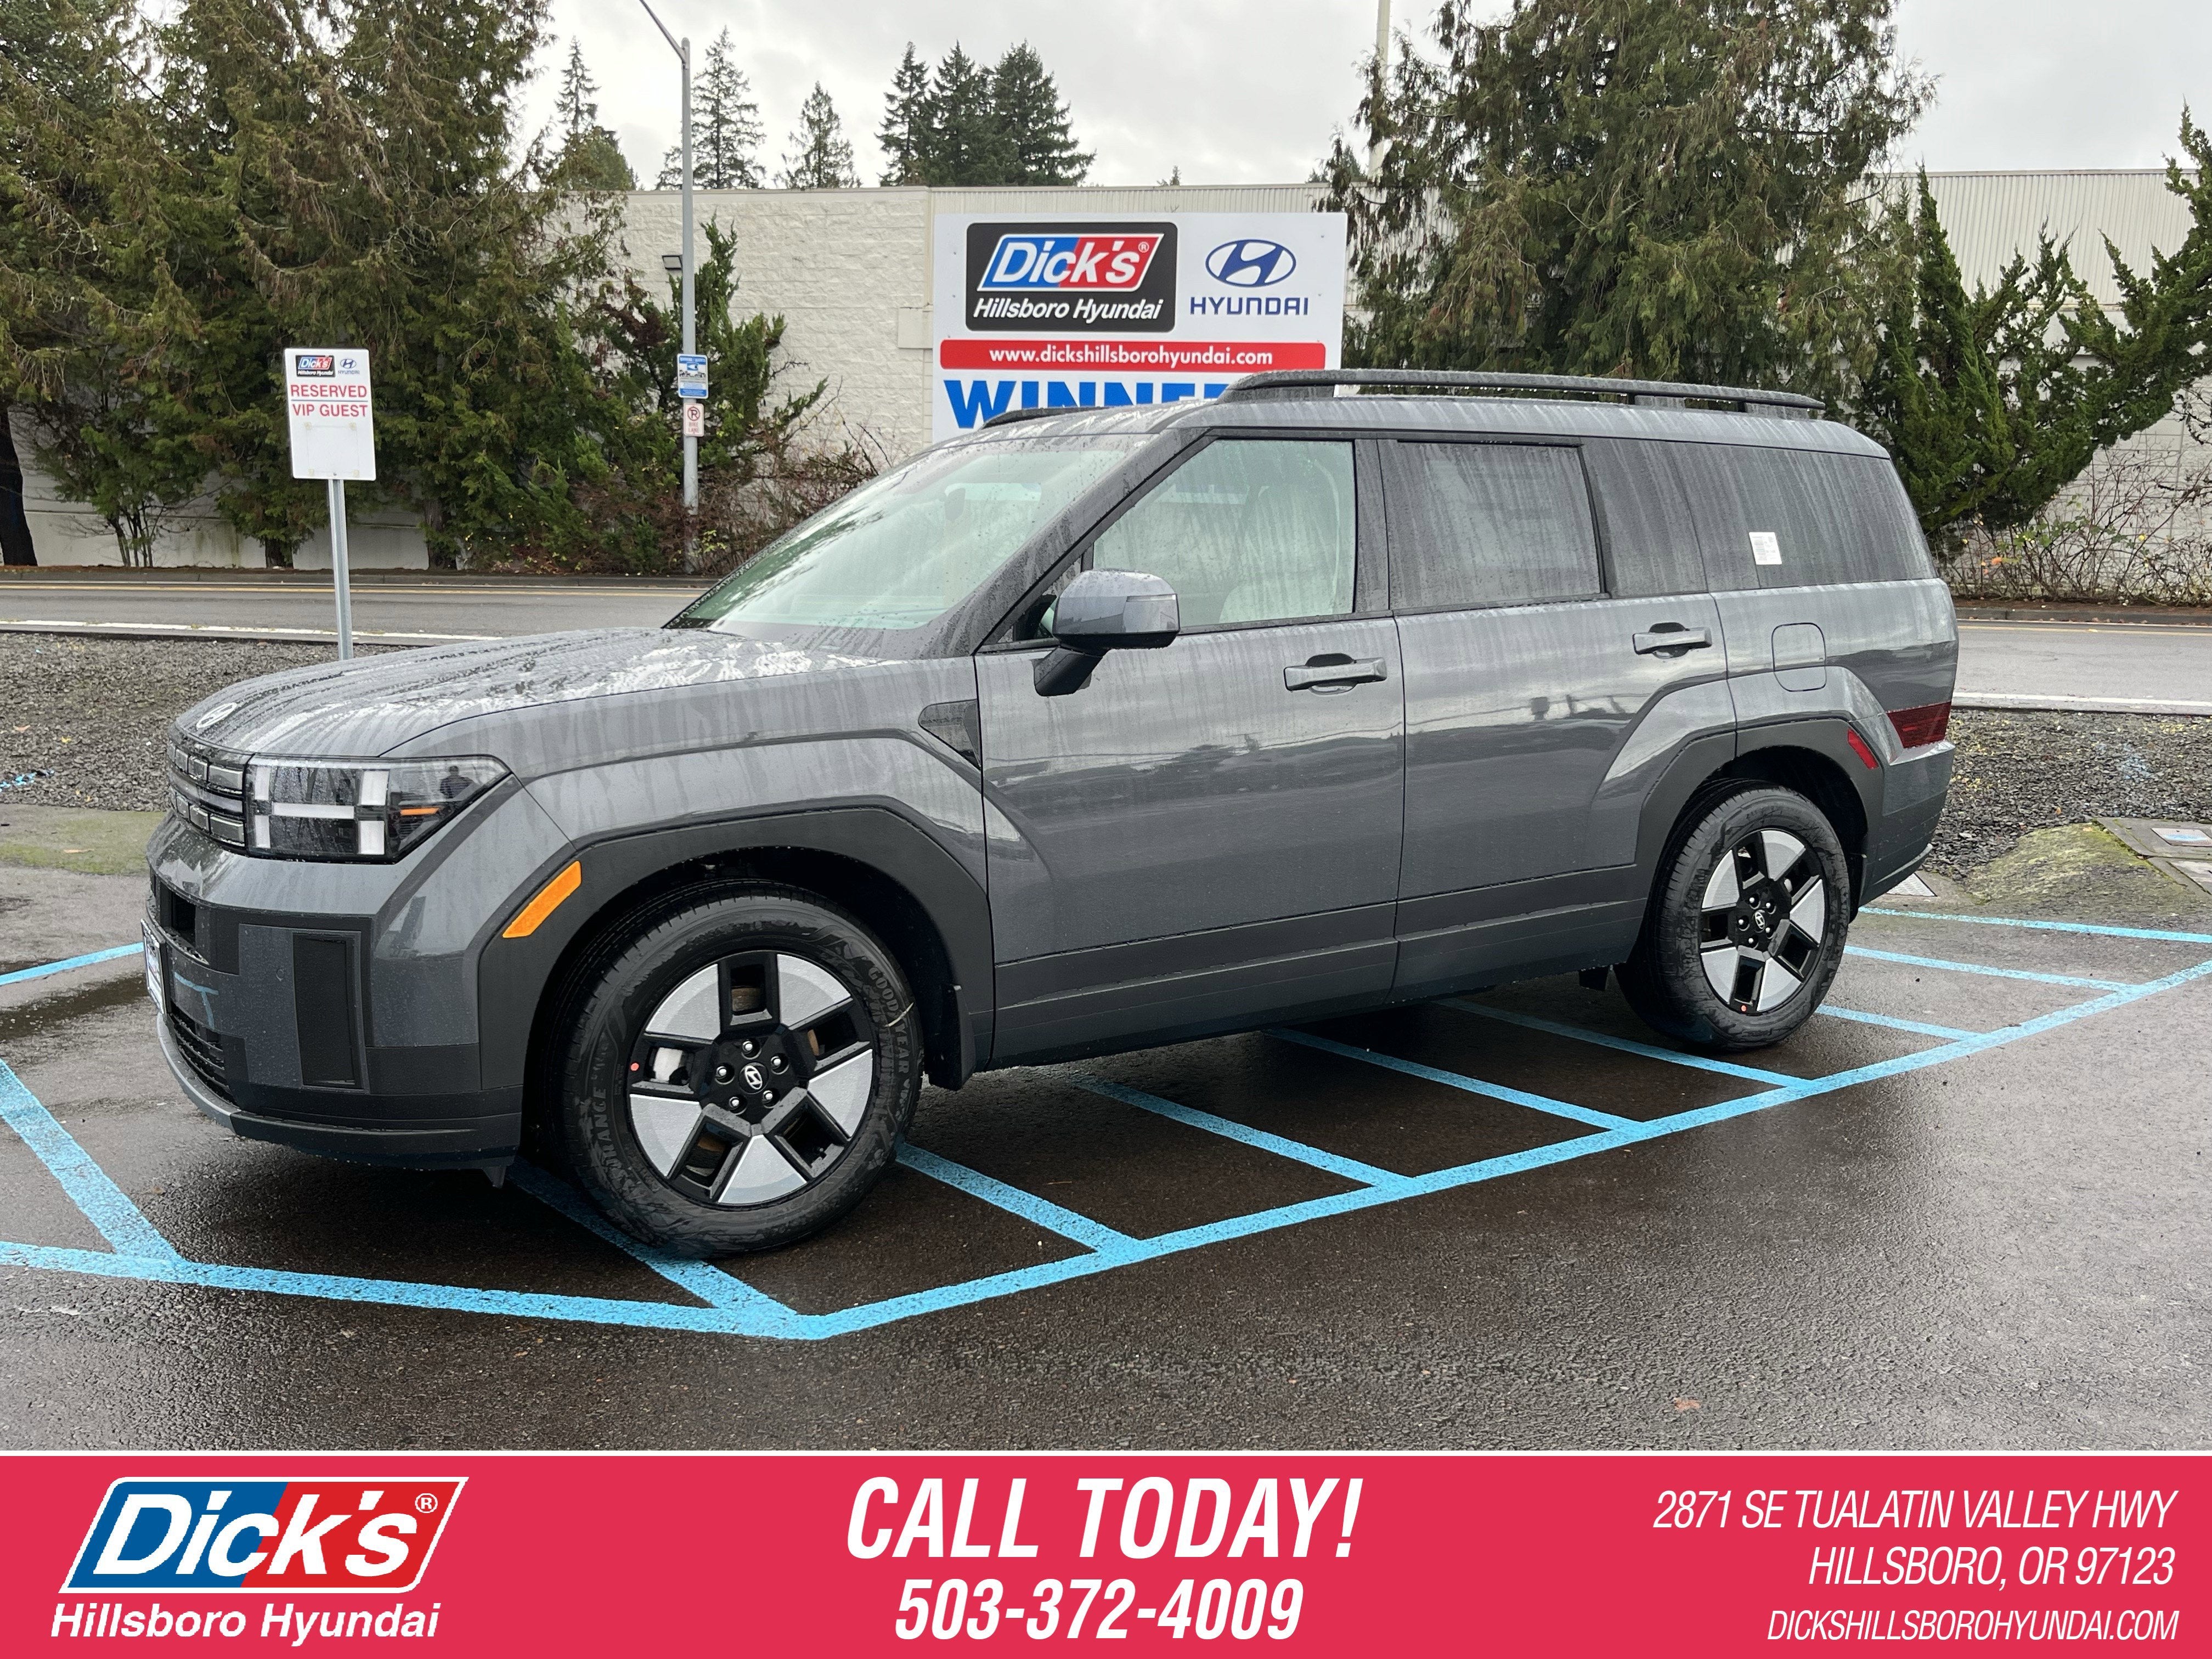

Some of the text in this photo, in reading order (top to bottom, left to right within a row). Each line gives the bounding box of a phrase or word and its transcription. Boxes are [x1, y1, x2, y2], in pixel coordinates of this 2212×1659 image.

[992, 241, 1139, 284] Dick's
[973, 298, 1164, 324] Hillsboro Hyundai
[1190, 297, 1308, 315] HYUNDAI
[989, 345, 1273, 369] www.dickshillsborohyundai.com
[291, 385, 367, 398] RESERVED
[292, 404, 368, 417] VIP GUEST
[944, 380, 1229, 428] WINN
